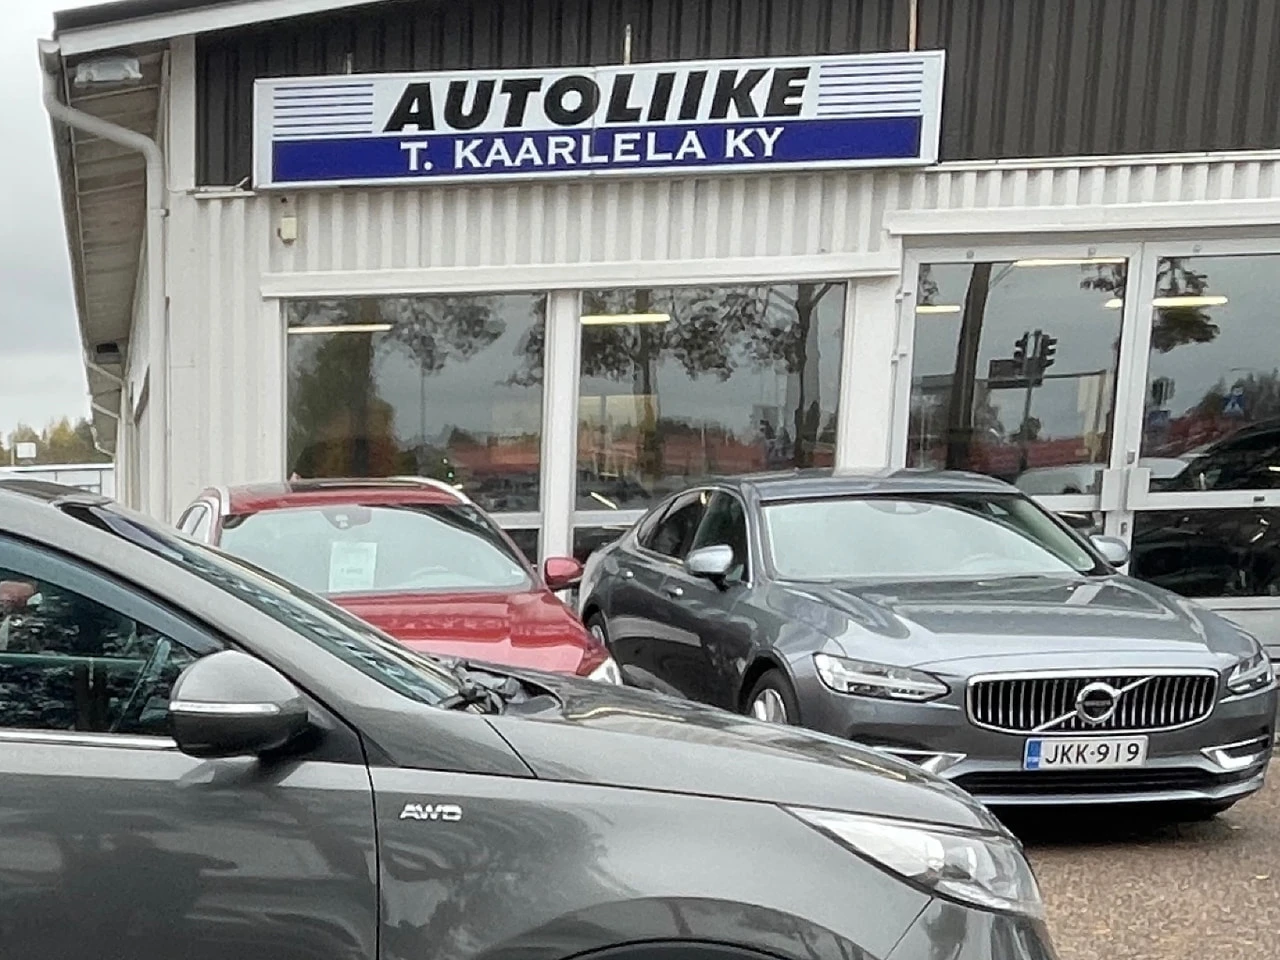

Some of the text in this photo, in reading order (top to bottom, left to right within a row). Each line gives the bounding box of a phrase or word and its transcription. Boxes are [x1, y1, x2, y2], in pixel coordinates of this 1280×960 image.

[382, 66, 811, 133] AUTOLIIKE
[400, 126, 785, 171] T. KAARLELA KY
[399, 803, 462, 820] AWD
